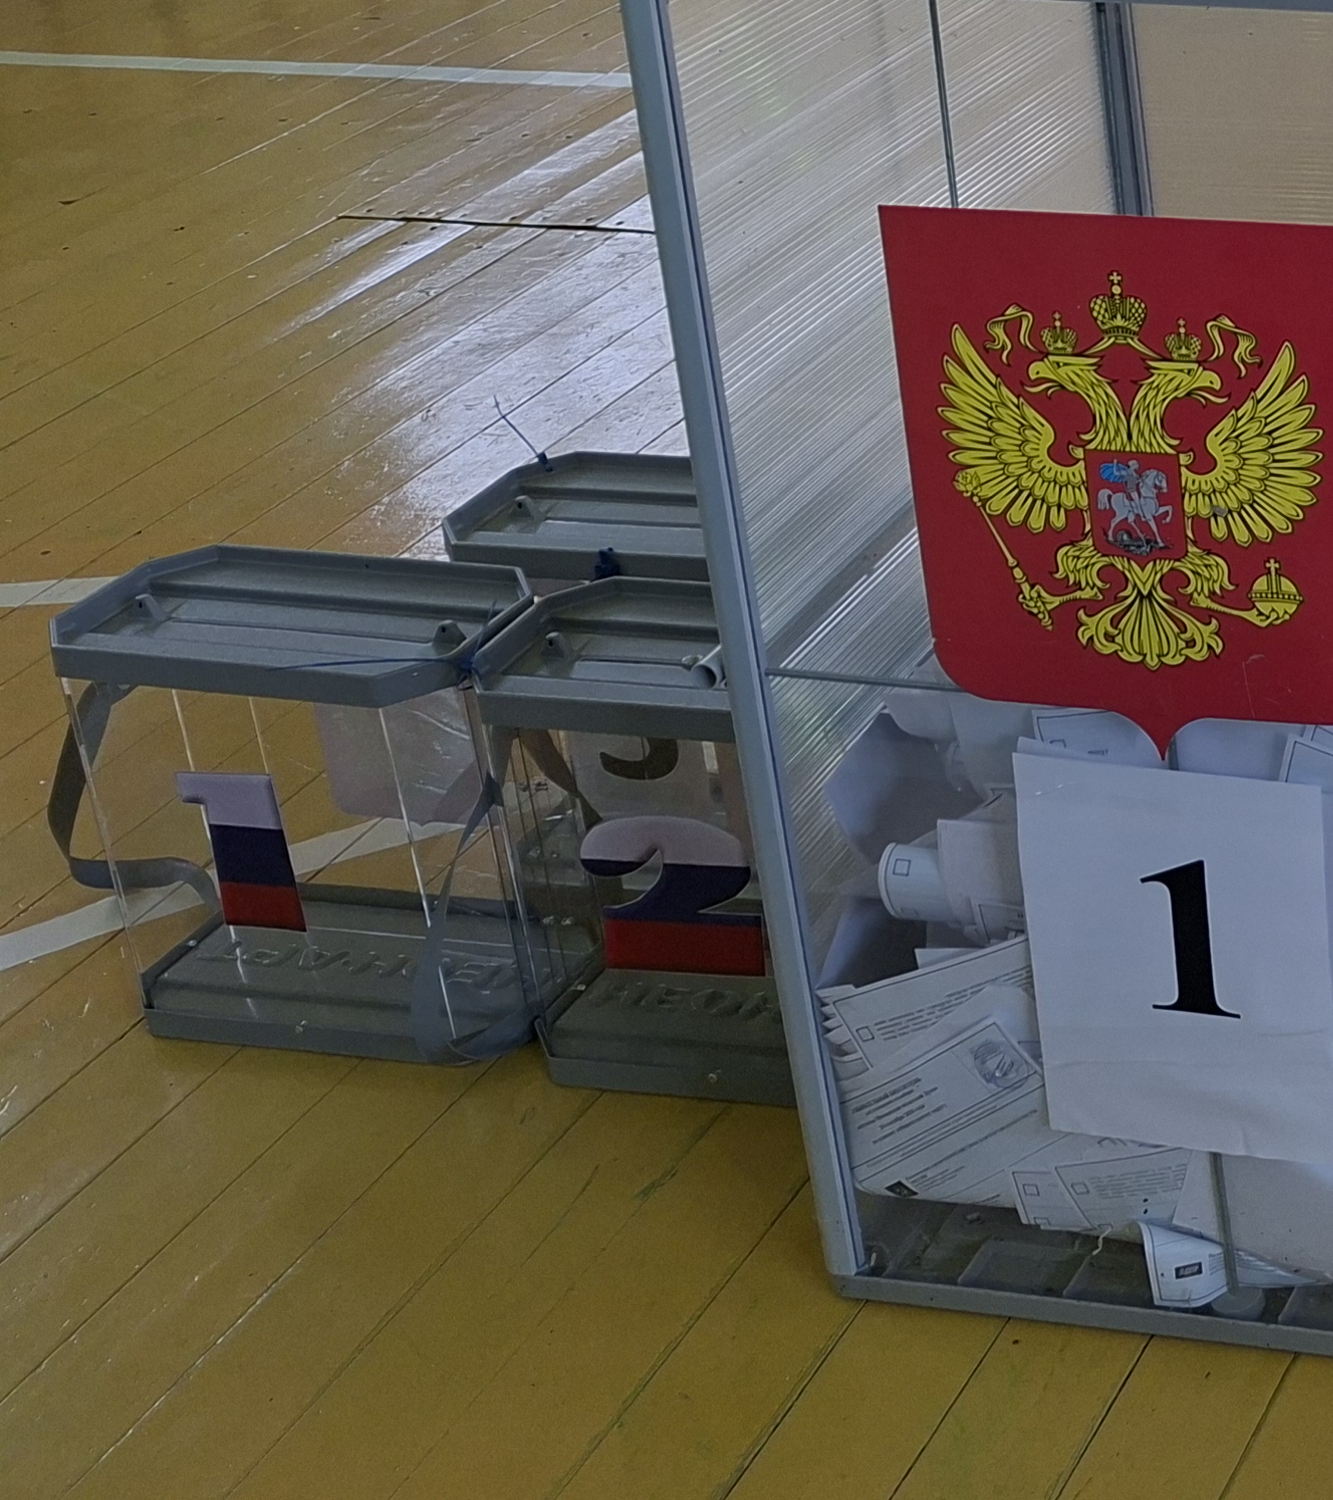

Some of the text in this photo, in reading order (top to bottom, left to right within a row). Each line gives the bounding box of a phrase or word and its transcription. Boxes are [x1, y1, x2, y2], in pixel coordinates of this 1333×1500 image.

[176, 771, 307, 933] 1
[580, 816, 766, 978] 2
[1139, 858, 1241, 1020] 1
